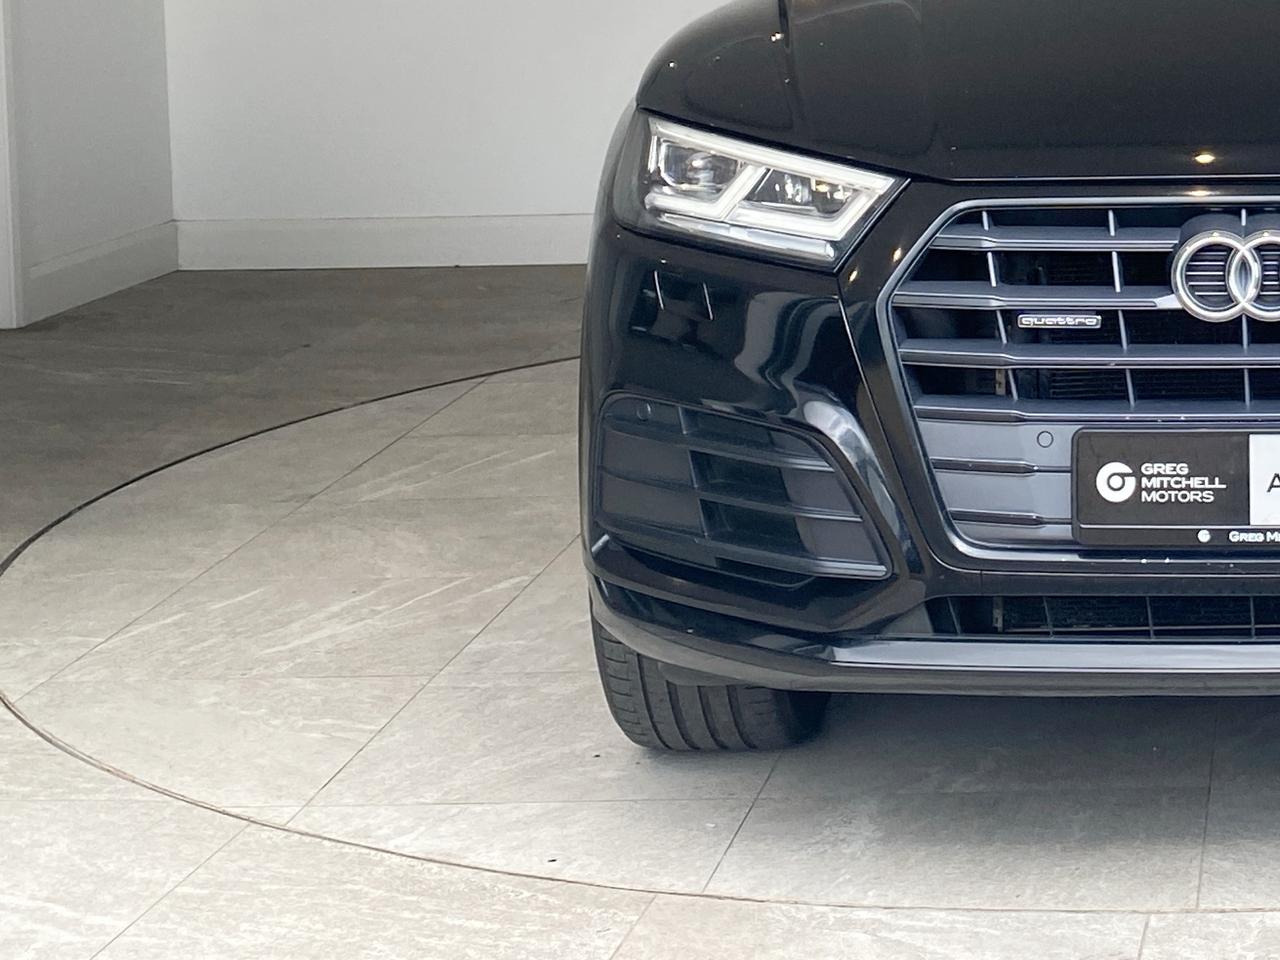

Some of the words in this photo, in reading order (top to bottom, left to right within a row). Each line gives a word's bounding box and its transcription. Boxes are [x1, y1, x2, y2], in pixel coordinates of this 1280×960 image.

[1020, 316, 1097, 327] quattro
[1140, 462, 1189, 475] GREG
[1141, 476, 1227, 489] MITCHELL
[1141, 490, 1215, 503] MOTORS
[1229, 530, 1264, 542] GREG
